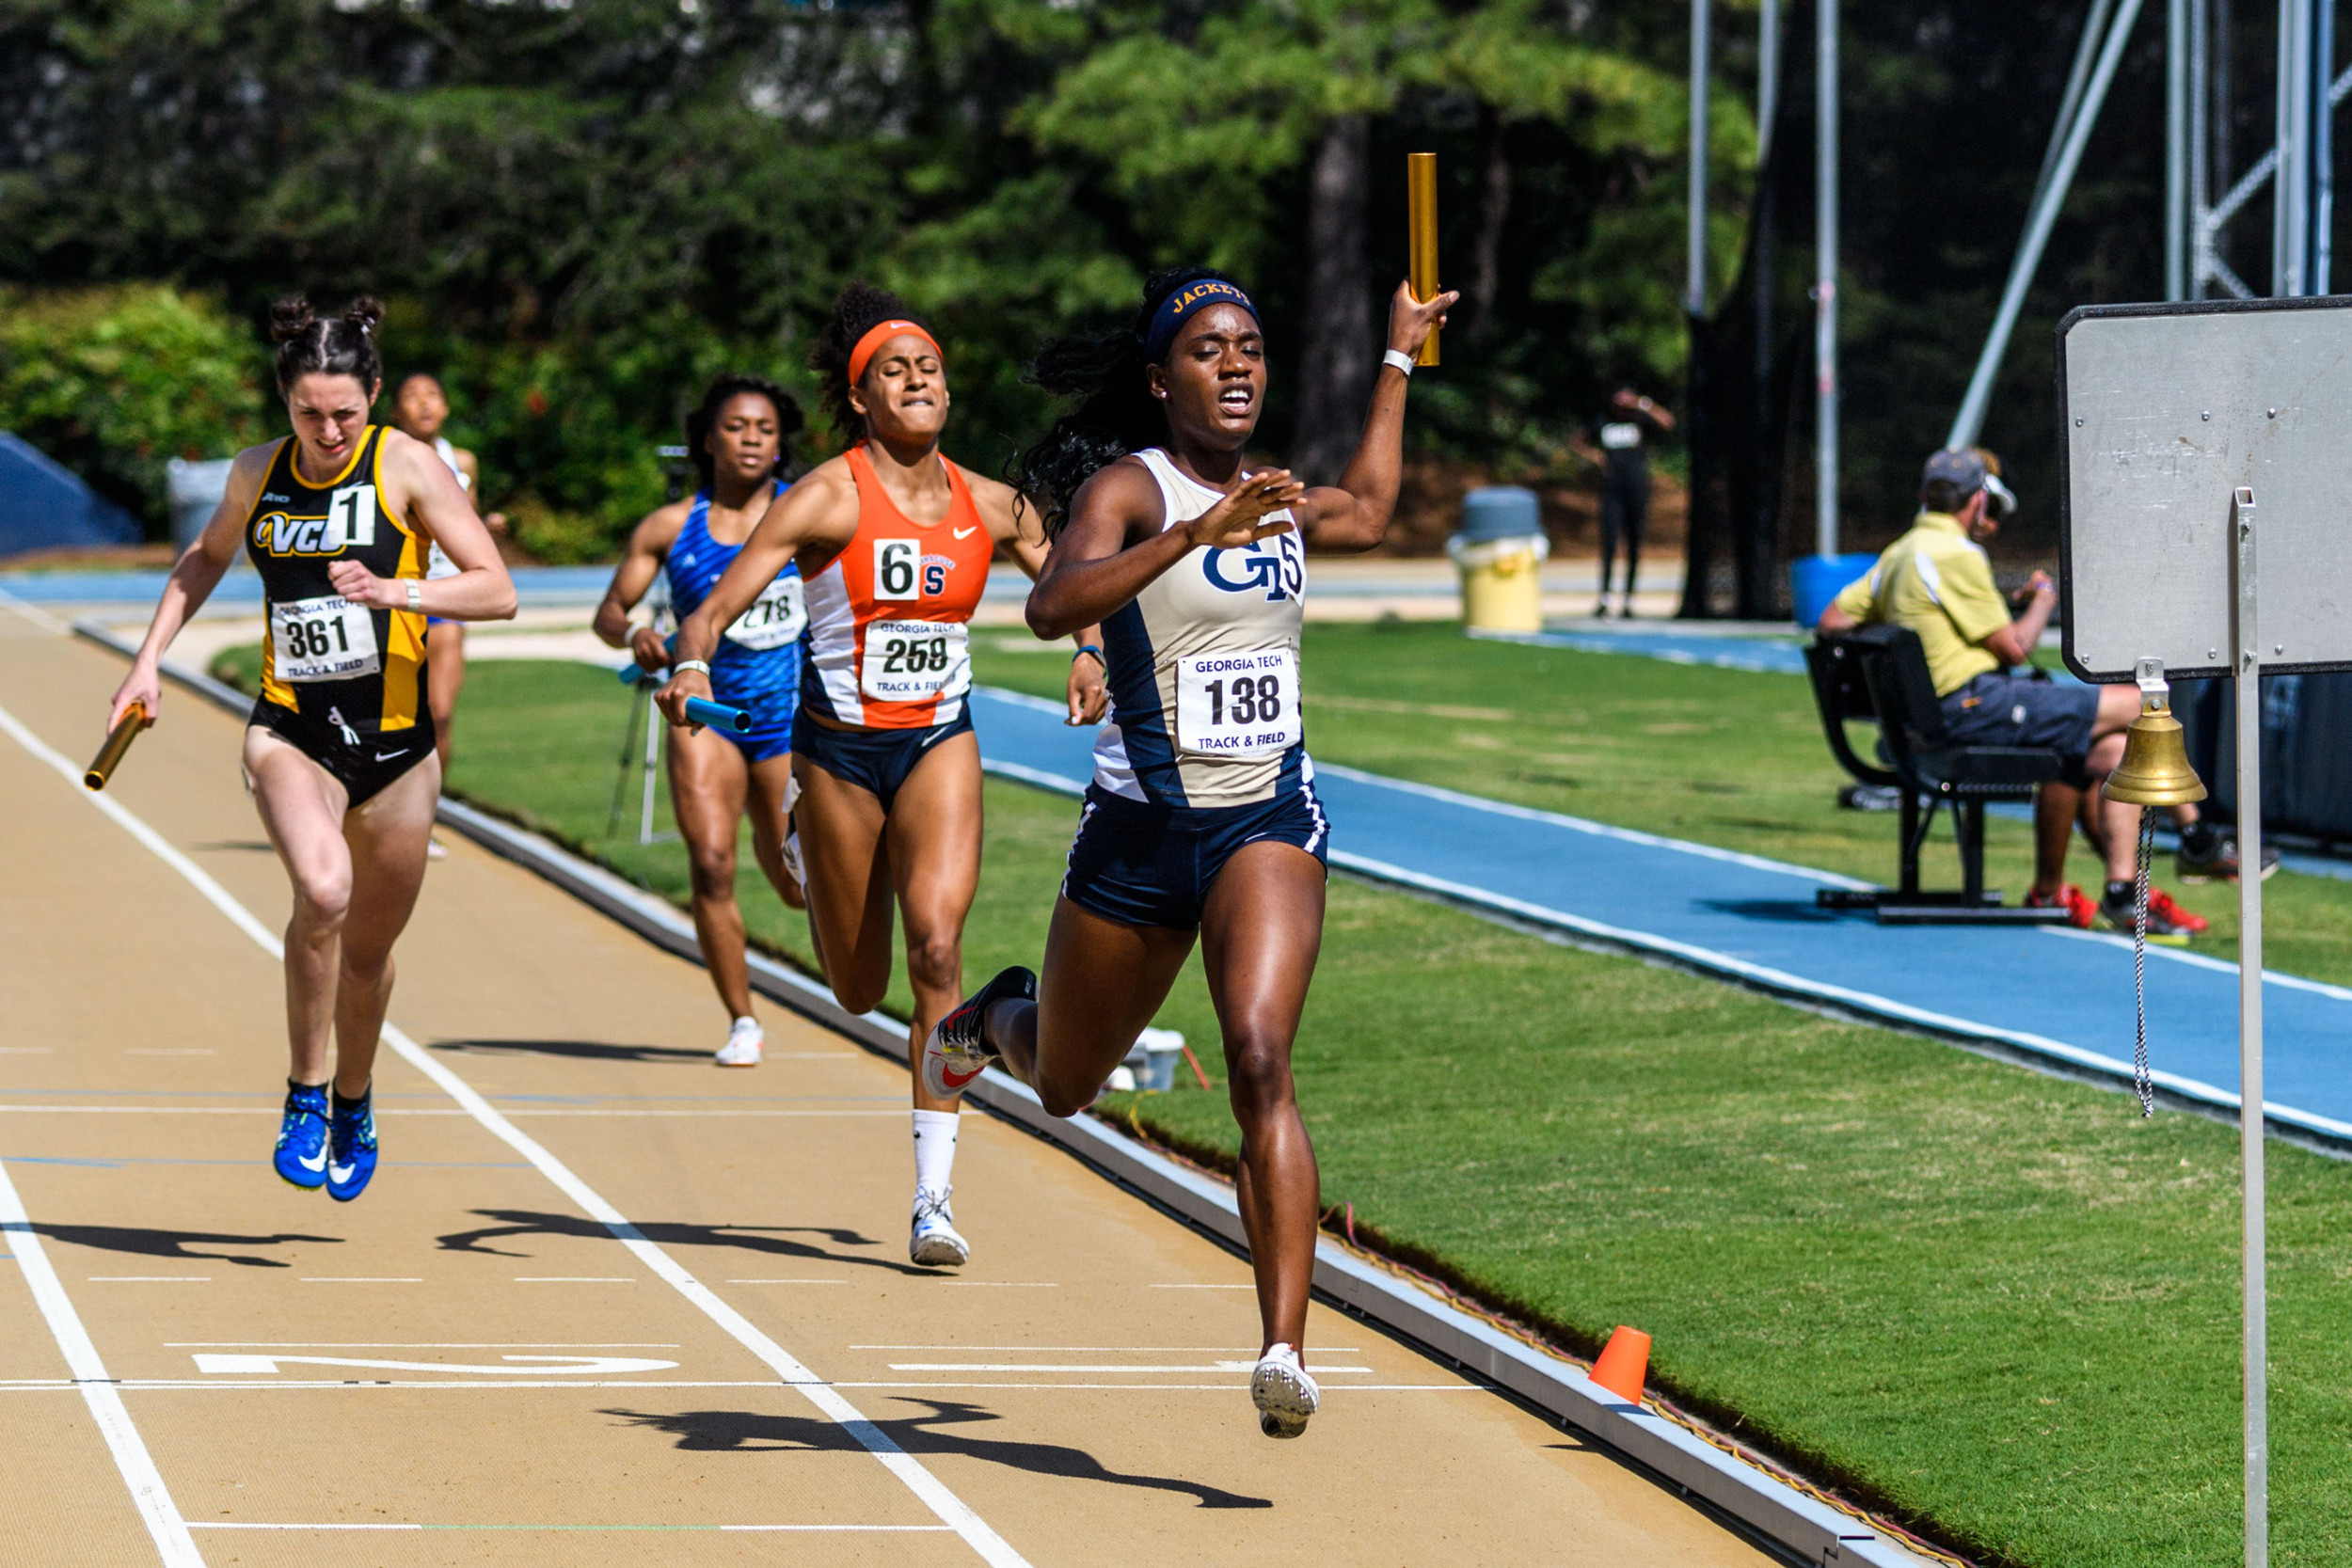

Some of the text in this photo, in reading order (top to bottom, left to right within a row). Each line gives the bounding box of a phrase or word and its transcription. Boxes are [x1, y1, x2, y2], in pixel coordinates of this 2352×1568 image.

[339, 491, 359, 541] 1
[881, 543, 914, 595] 6
[924, 564, 945, 595] S
[1278, 533, 1303, 595] 5
[287, 615, 349, 658] 361
[881, 623, 930, 634] GEORGIA
[288, 664, 320, 677] TRACK
[882, 637, 948, 673] 259
[1195, 655, 1282, 673] GEORGIA TECH
[877, 682, 911, 692] TRACK
[914, 681, 921, 691] &
[1204, 674, 1280, 726] 138
[1198, 732, 1286, 751] TRACK & FIELD
